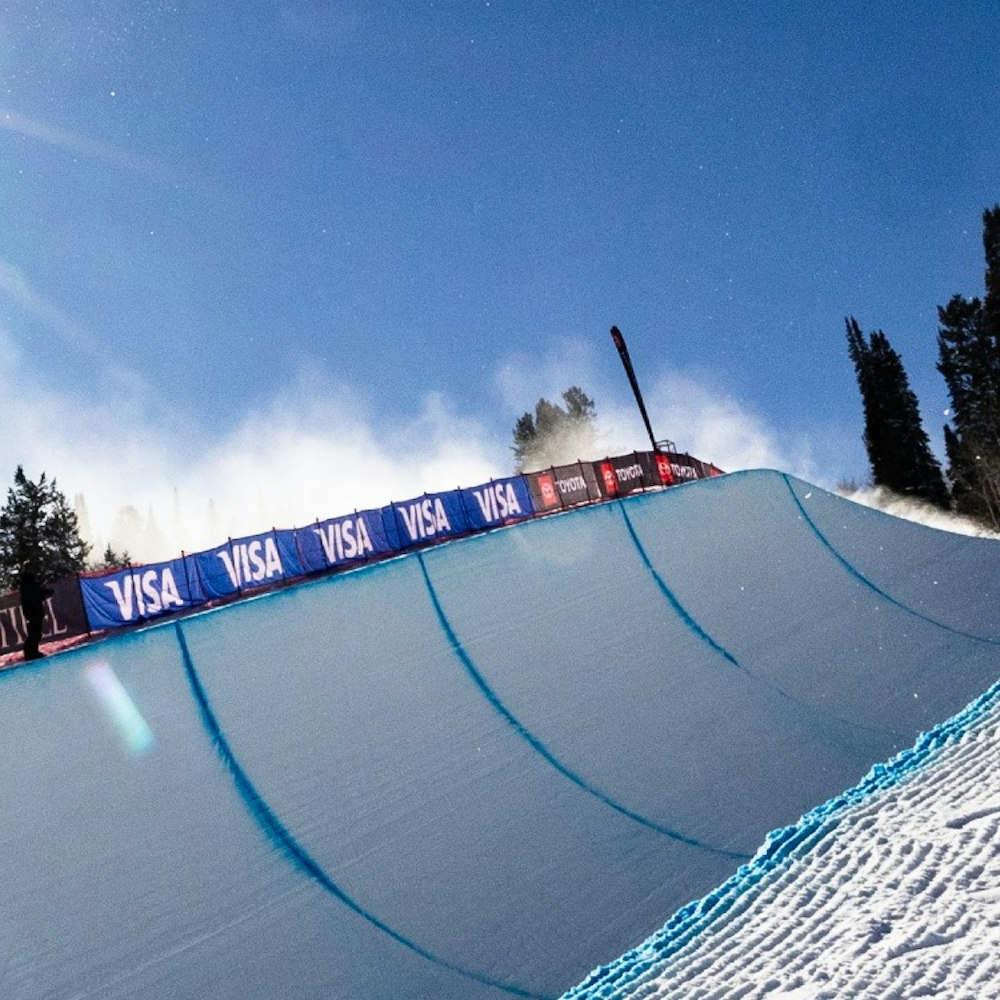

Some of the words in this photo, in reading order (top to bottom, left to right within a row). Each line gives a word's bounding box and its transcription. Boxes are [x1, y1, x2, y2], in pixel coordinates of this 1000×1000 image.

[555, 475, 587, 493] TOYOTA
[615, 463, 644, 482] TOYOTA
[670, 463, 699, 480] TOYOTA
[396, 497, 452, 541] VISA
[474, 482, 521, 523] VISA
[316, 516, 373, 563] VISA
[216, 536, 284, 588] VISA
[104, 567, 183, 621] VISA
